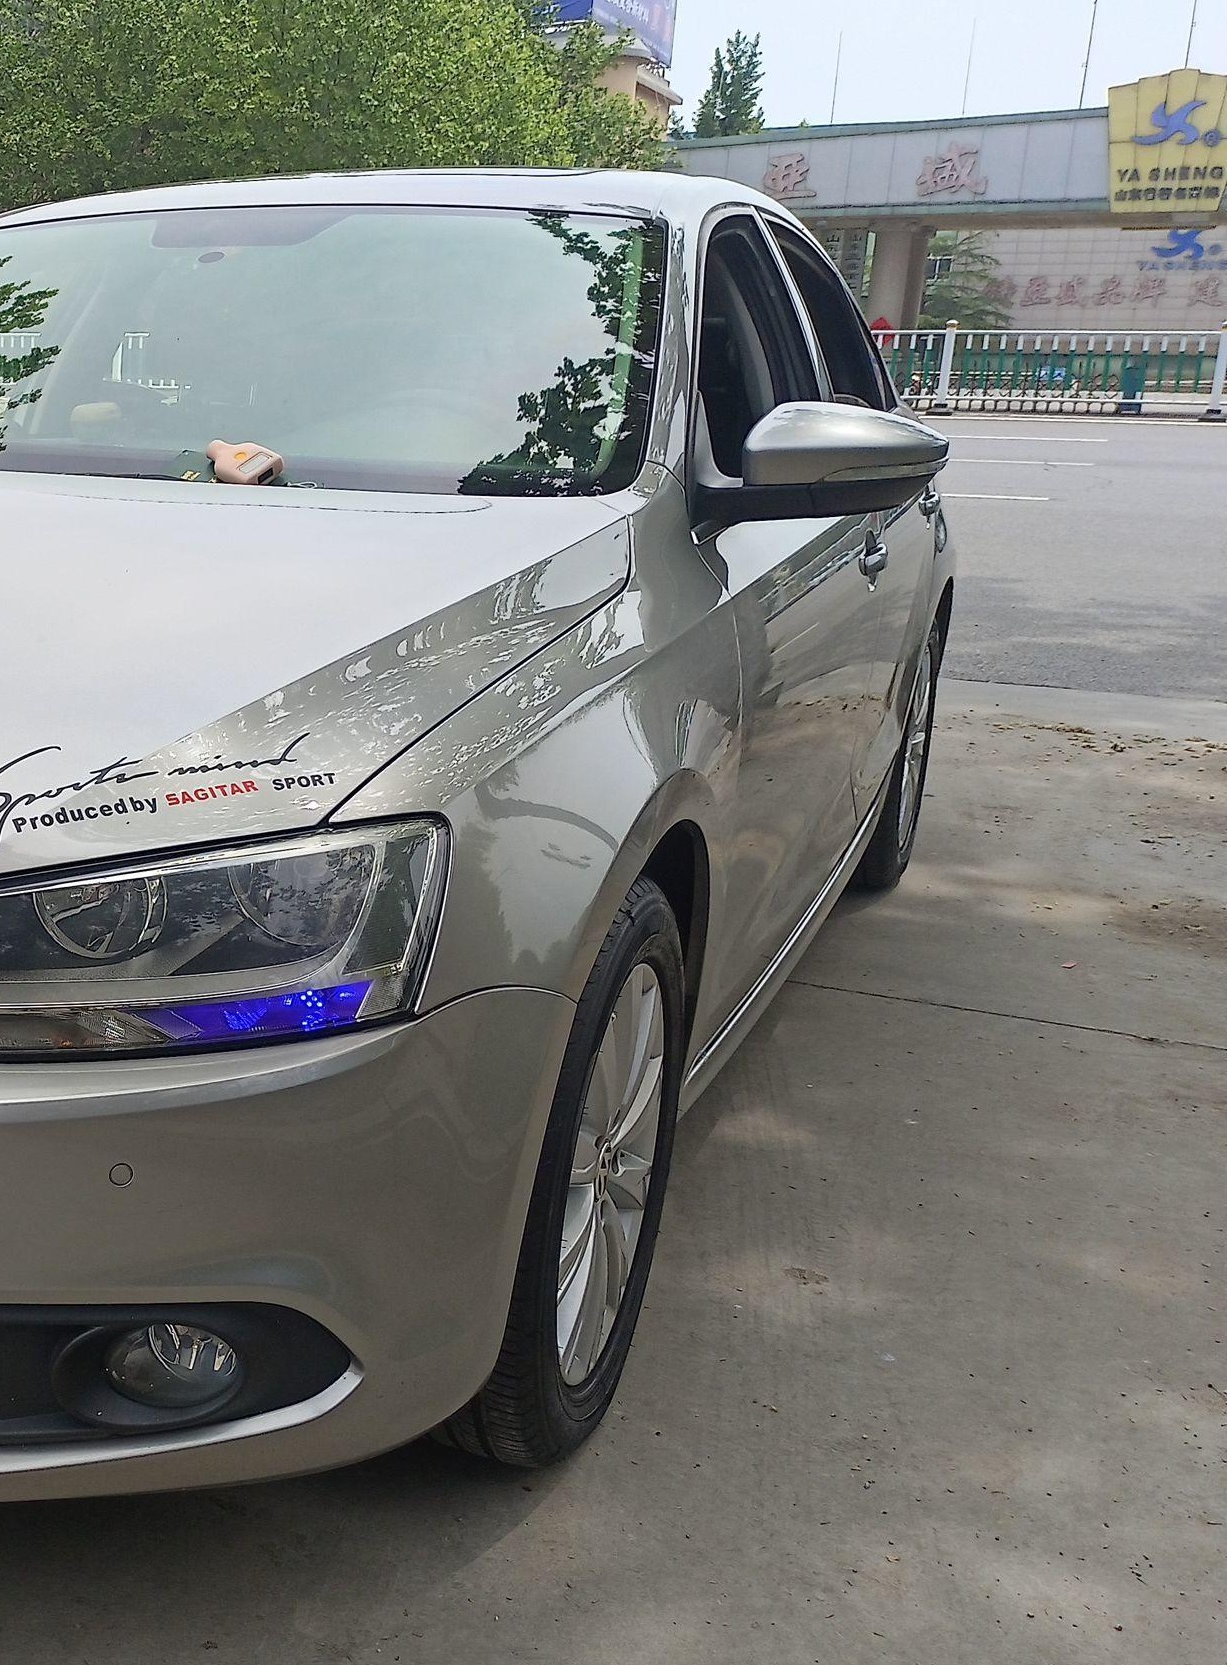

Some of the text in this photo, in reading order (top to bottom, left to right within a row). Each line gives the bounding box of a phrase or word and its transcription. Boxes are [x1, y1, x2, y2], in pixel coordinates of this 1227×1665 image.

[1117, 166, 1224, 182] YA SHENG
[165, 779, 259, 807] SAGITAR
[272, 772, 337, 792] SPORT
